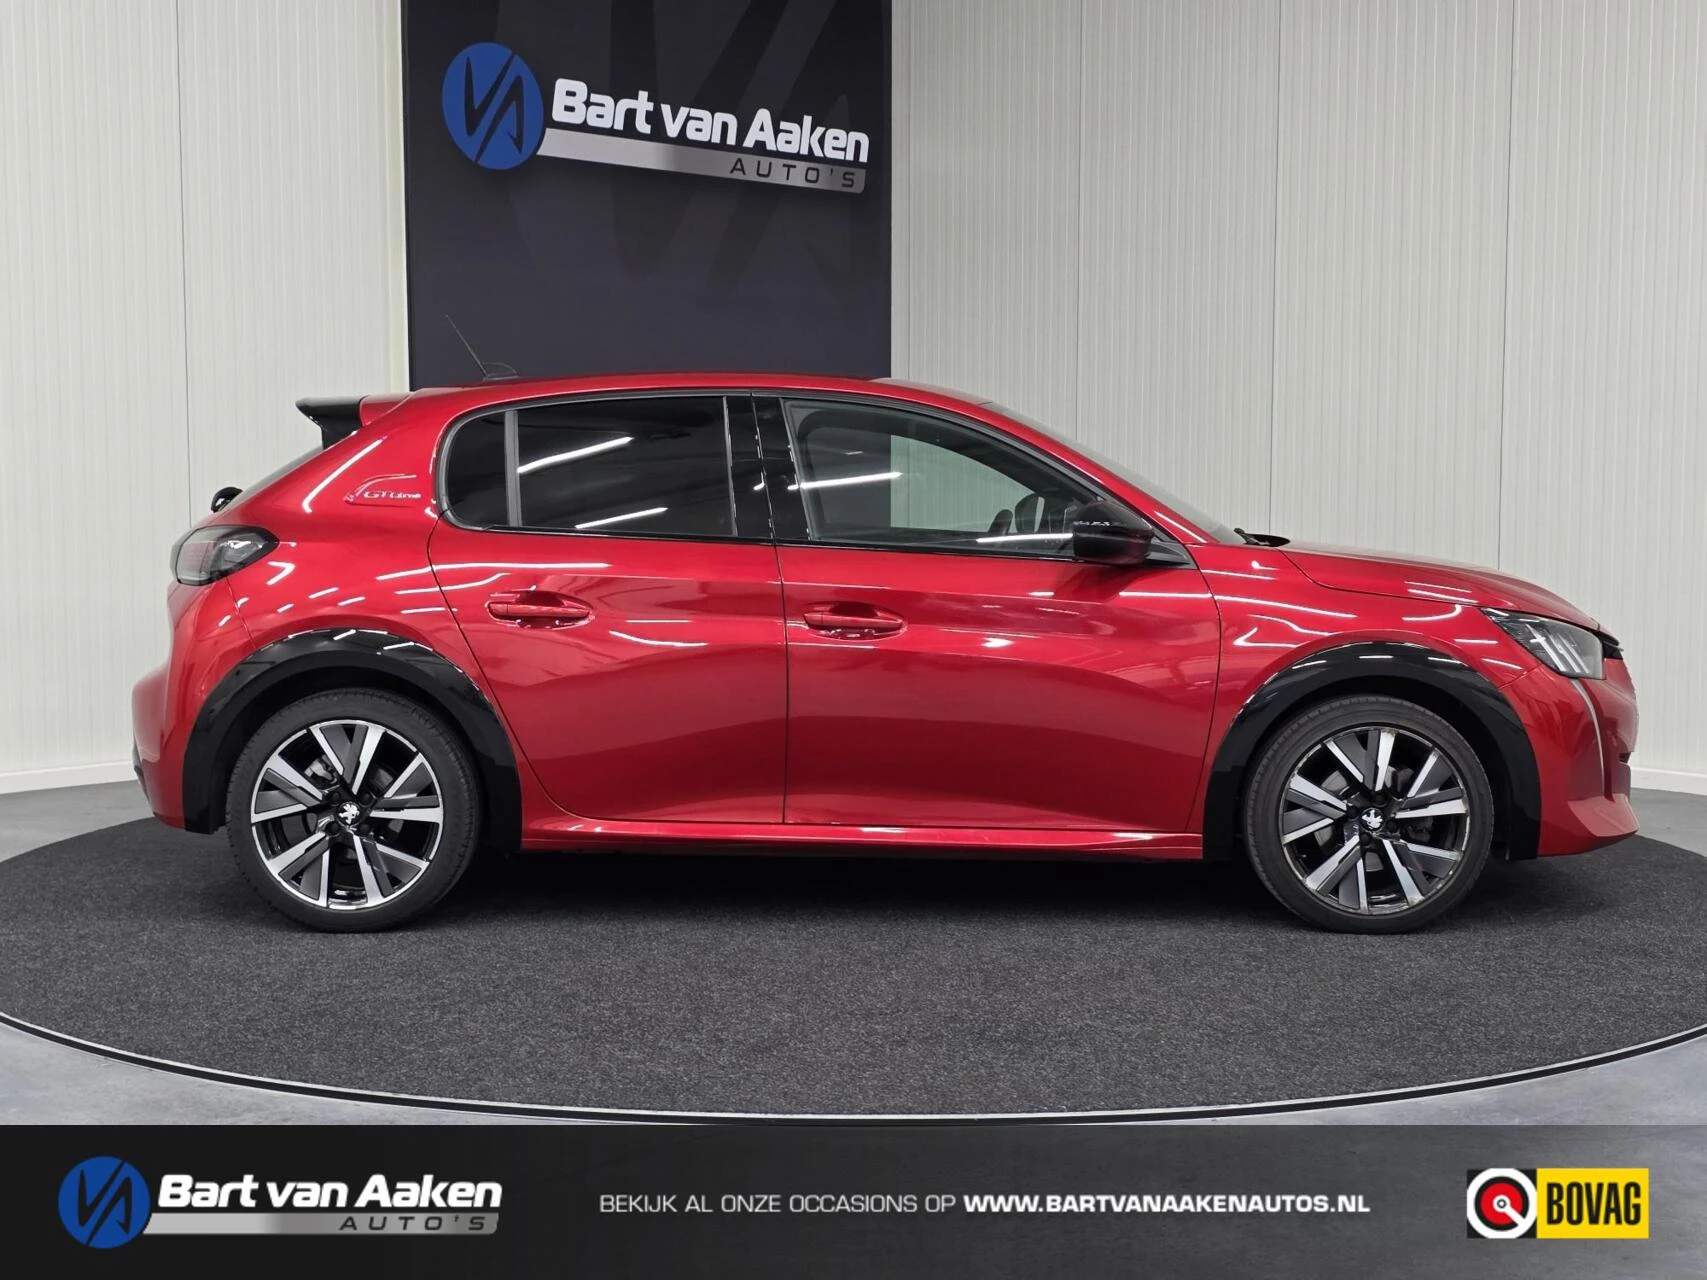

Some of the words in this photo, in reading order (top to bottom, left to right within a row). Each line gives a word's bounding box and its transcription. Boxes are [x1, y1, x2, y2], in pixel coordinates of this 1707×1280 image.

[551, 77, 655, 135] Bart
[660, 102, 738, 146] van
[742, 108, 870, 163] Aaken
[729, 157, 856, 188] AUTO'S
